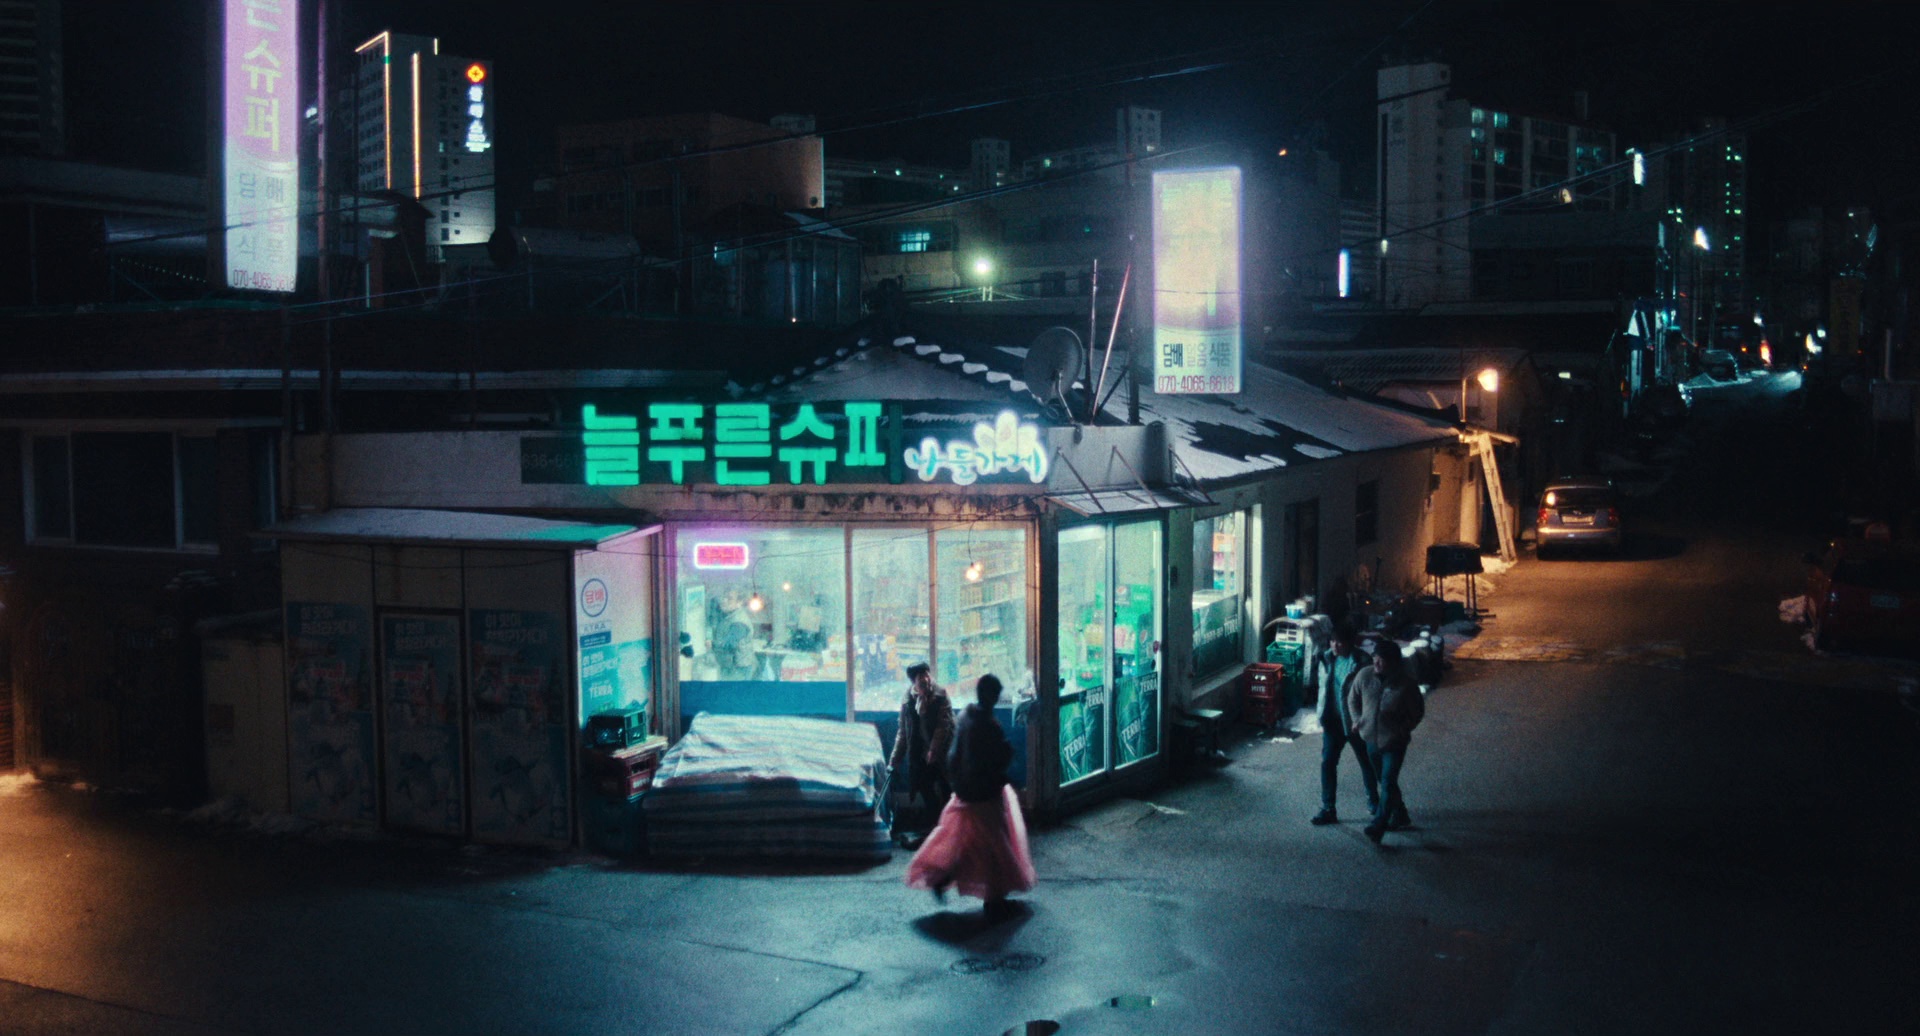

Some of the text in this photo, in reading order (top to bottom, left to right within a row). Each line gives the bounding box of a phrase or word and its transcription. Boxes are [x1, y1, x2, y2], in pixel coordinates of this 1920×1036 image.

[1163, 343, 1183, 367] 담배
[1158, 375, 1234, 392] 070-4065-6618
[589, 685, 612, 699] TERRA
